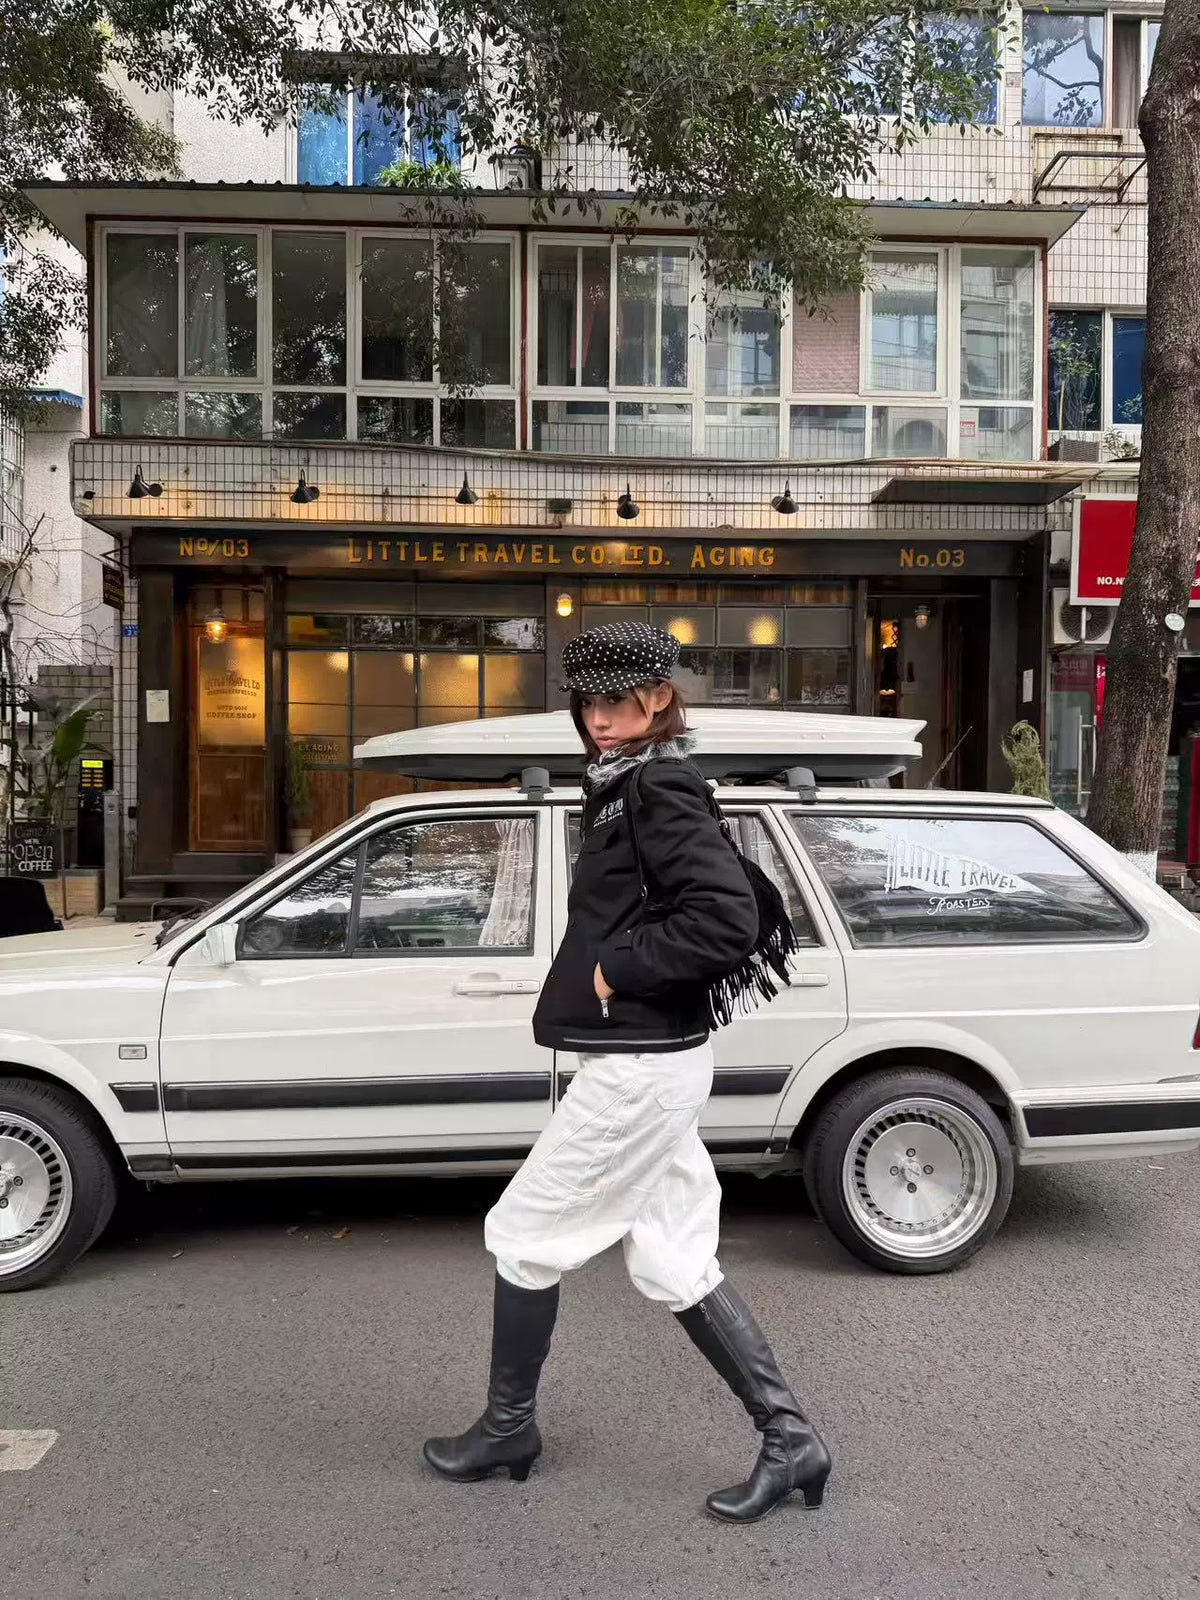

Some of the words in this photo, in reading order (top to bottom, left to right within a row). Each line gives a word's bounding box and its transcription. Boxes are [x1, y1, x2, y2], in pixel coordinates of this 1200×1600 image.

[348, 538, 446, 563] LITTLE
[456, 542, 562, 564] TRAVEL
[690, 545, 775, 568] AGING
[900, 548, 965, 568] No.03
[18, 860, 53, 871] COFFEE
[959, 858, 1017, 889] TRAVEL
